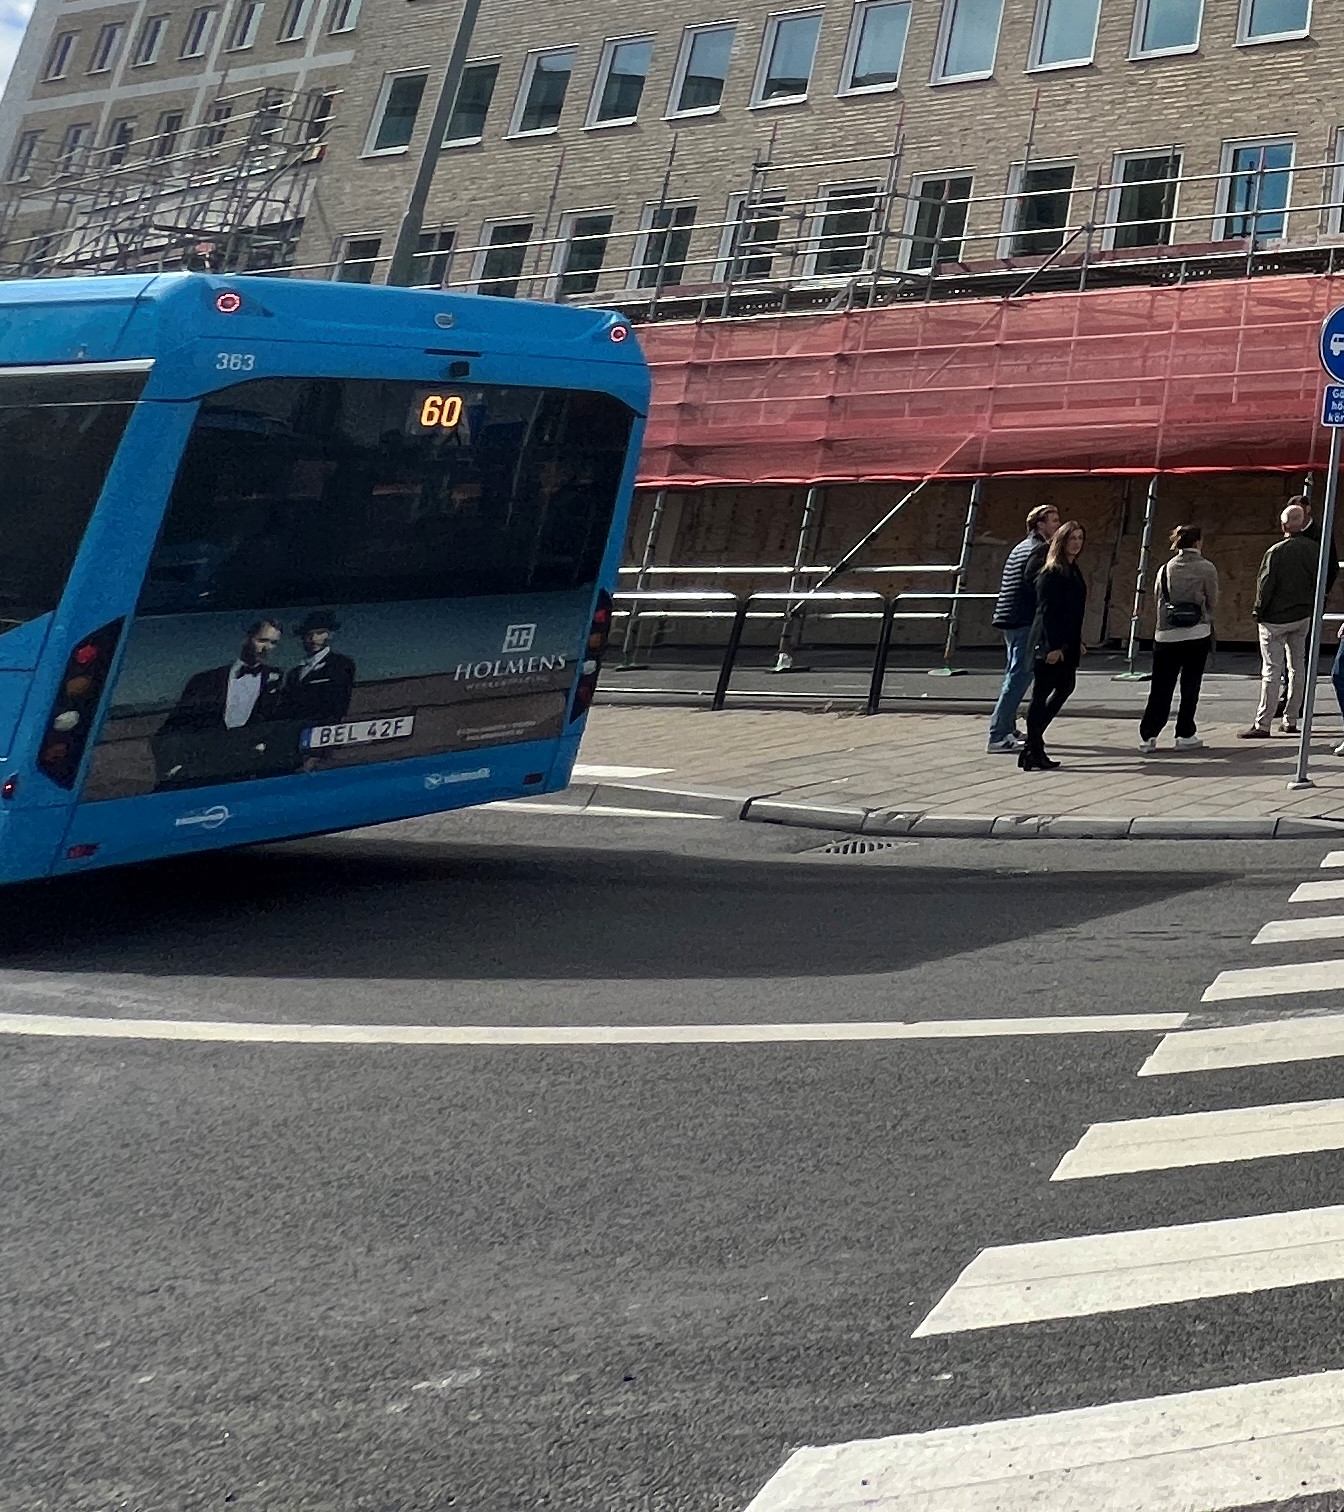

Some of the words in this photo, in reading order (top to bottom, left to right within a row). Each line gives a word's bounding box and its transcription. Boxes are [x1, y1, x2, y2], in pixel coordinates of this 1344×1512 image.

[420, 394, 463, 428] 60
[453, 654, 568, 681] HOLMENS
[320, 725, 358, 746] BEL
[367, 718, 405, 738] 42F
